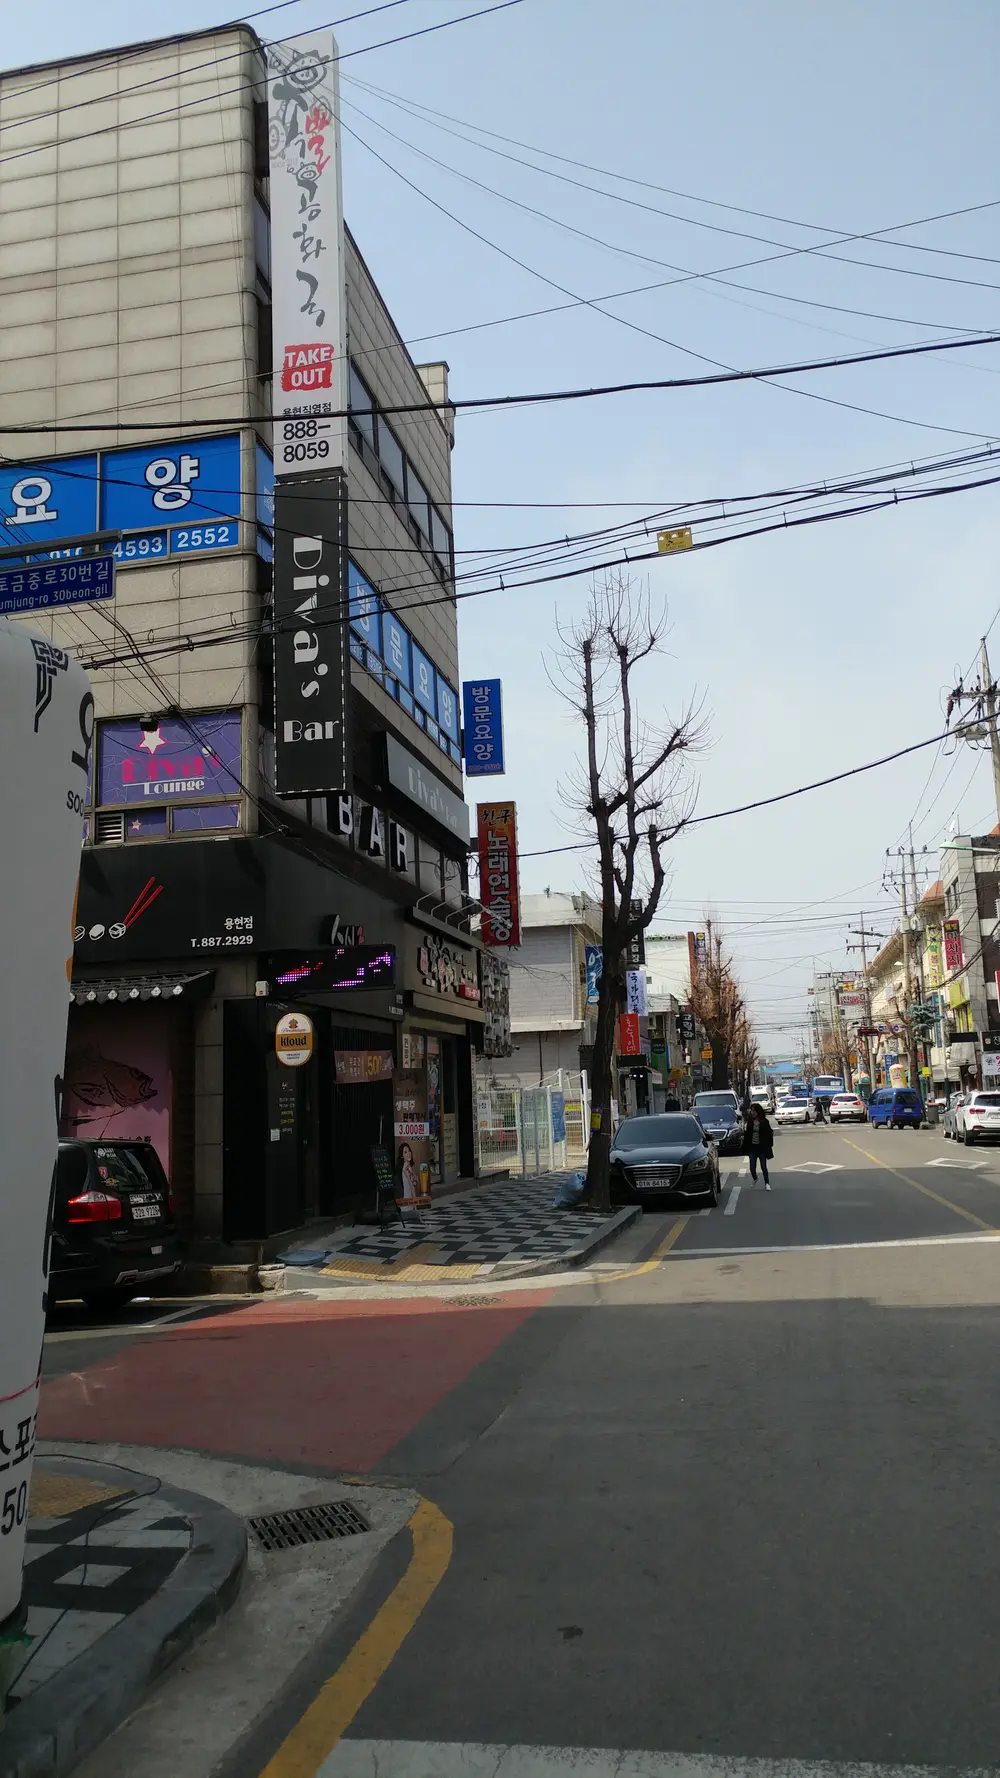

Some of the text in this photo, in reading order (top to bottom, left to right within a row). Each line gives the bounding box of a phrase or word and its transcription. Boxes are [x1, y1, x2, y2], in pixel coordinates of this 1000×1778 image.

[285, 347, 332, 368] TAKE
[291, 367, 326, 387] OUT
[283, 440, 330, 463] 8059
[112, 537, 163, 558] 4593
[177, 526, 230, 548] 2552
[52, 584, 109, 602] 30beon-gil
[292, 534, 330, 699] Diva's
[283, 719, 339, 743] Bar
[472, 686, 494, 761] 방문요양
[143, 779, 205, 795] Lounge
[480, 809, 513, 825] 친구
[337, 793, 409, 872] BAR
[487, 830, 514, 943] 노래연습장
[223, 916, 253, 931] 용현점
[190, 934, 253, 949] T.887.2929
[399, 1124, 425, 1135] 3.000원
